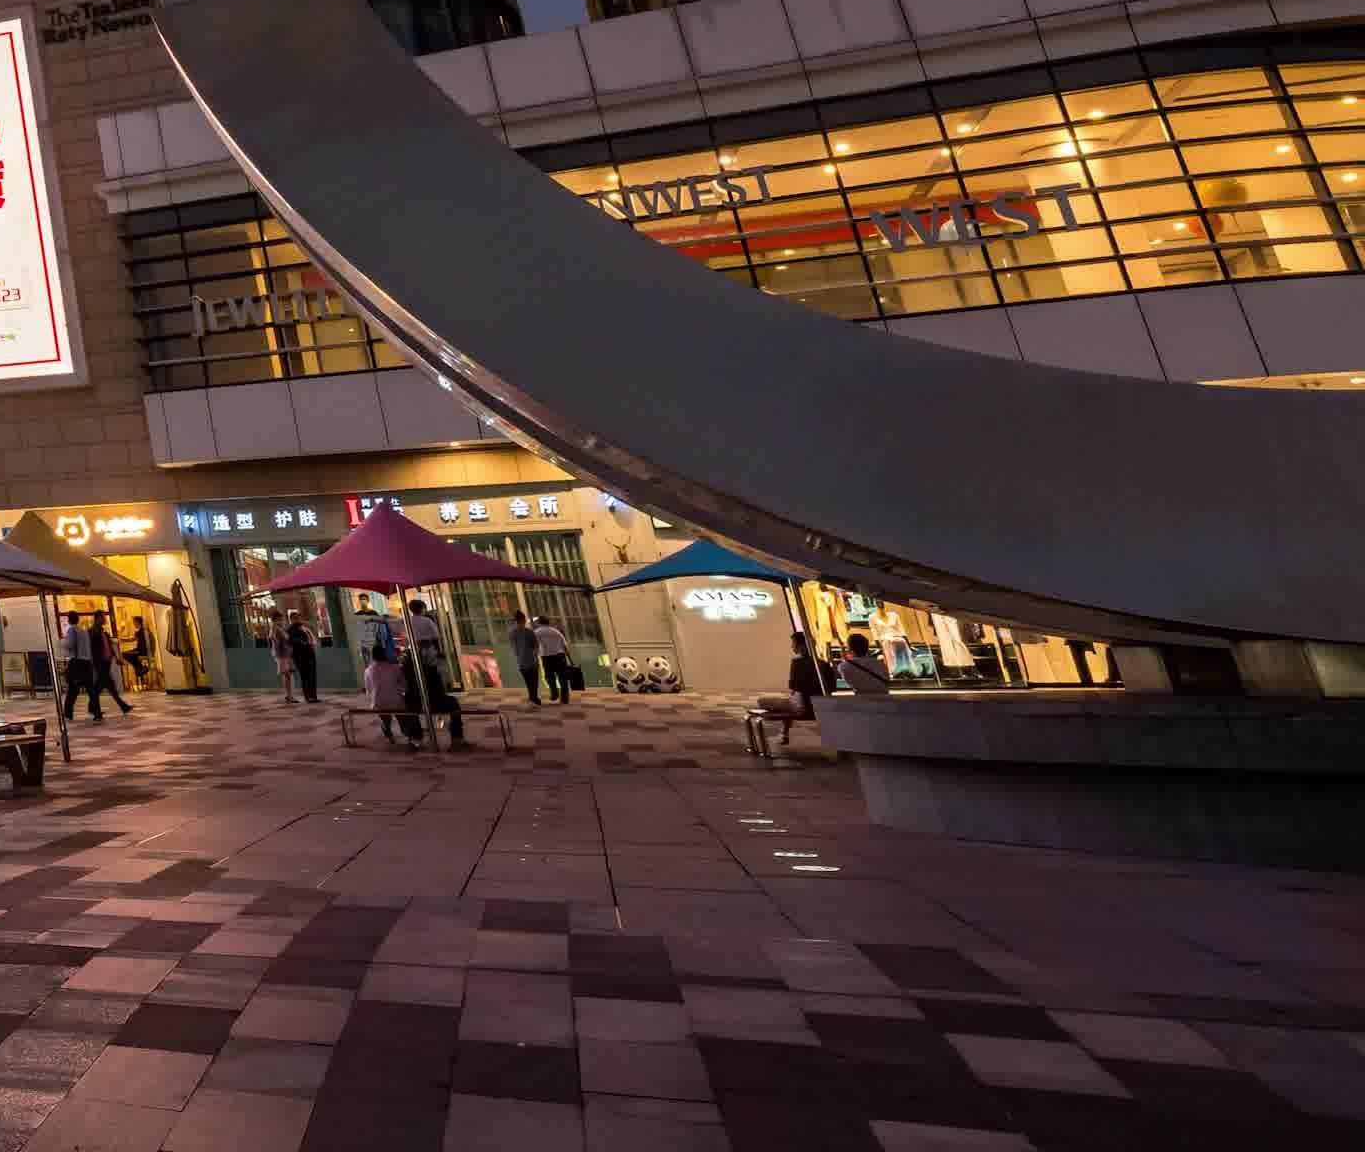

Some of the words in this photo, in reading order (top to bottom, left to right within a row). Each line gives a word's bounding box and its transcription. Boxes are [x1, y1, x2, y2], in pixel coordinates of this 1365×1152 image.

[871, 183, 1081, 251] WEST
[212, 512, 255, 531] 造型
[274, 509, 318, 528] 护肤
[438, 500, 488, 522] 养生
[509, 496, 559, 519] 会所
